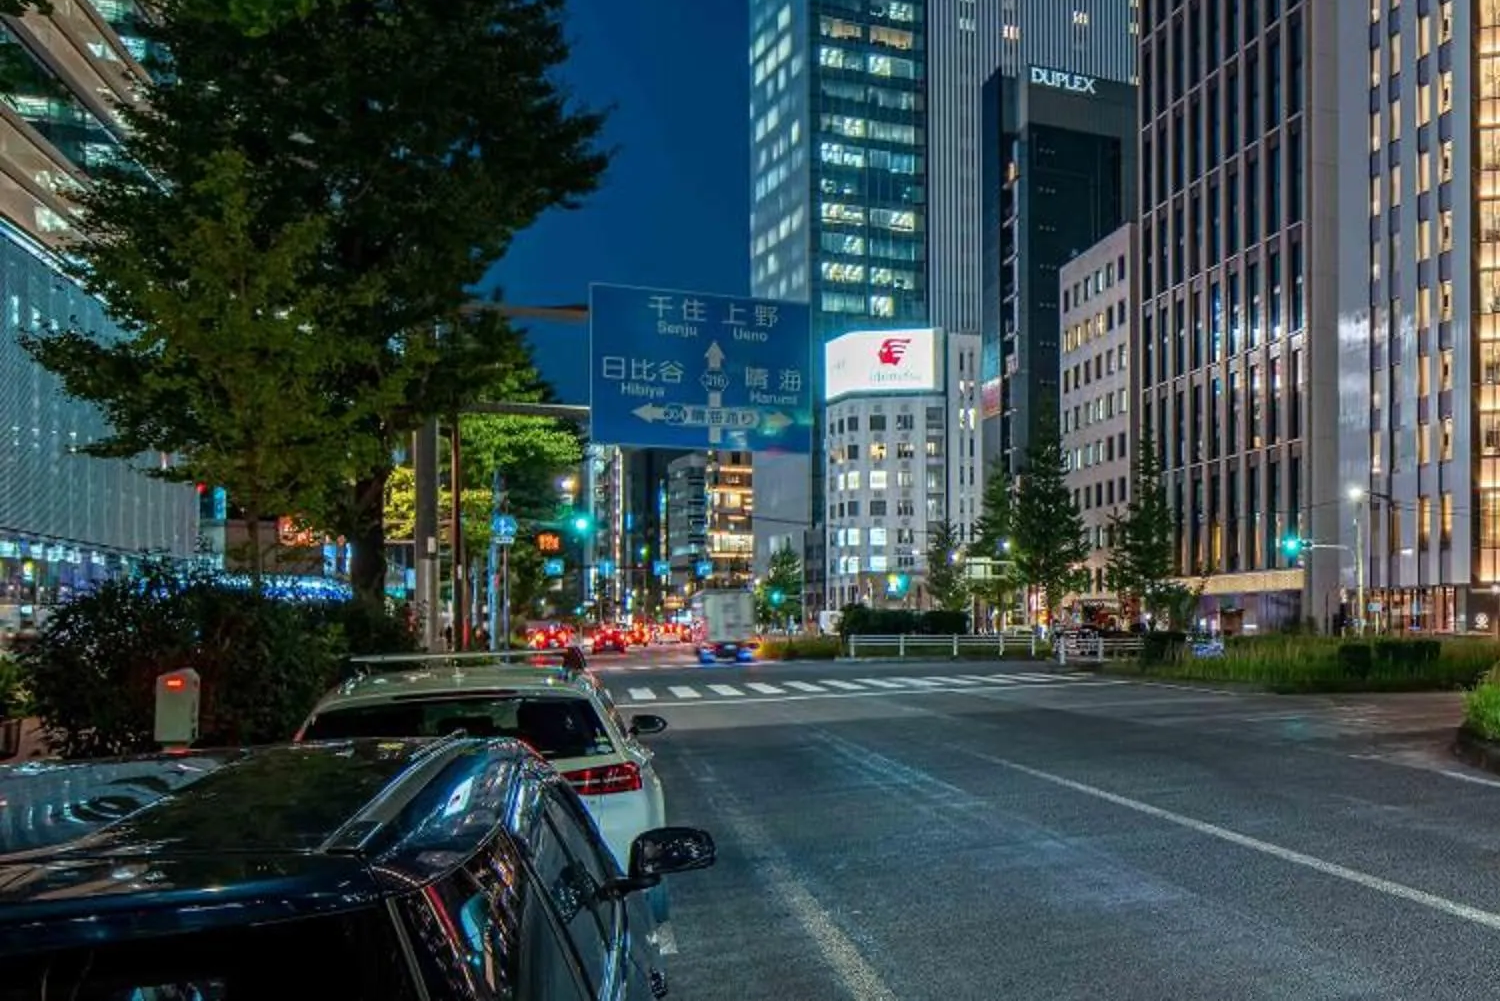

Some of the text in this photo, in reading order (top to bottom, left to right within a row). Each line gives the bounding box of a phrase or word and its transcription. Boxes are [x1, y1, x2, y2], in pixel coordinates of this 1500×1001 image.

[1031, 67, 1096, 94] DUPLEX
[648, 296, 778, 328] 千住 上野
[657, 320, 768, 342] Senju Ueno
[603, 356, 684, 384] 日比谷
[621, 382, 665, 399] Hibiya
[751, 390, 798, 406] Harumi
